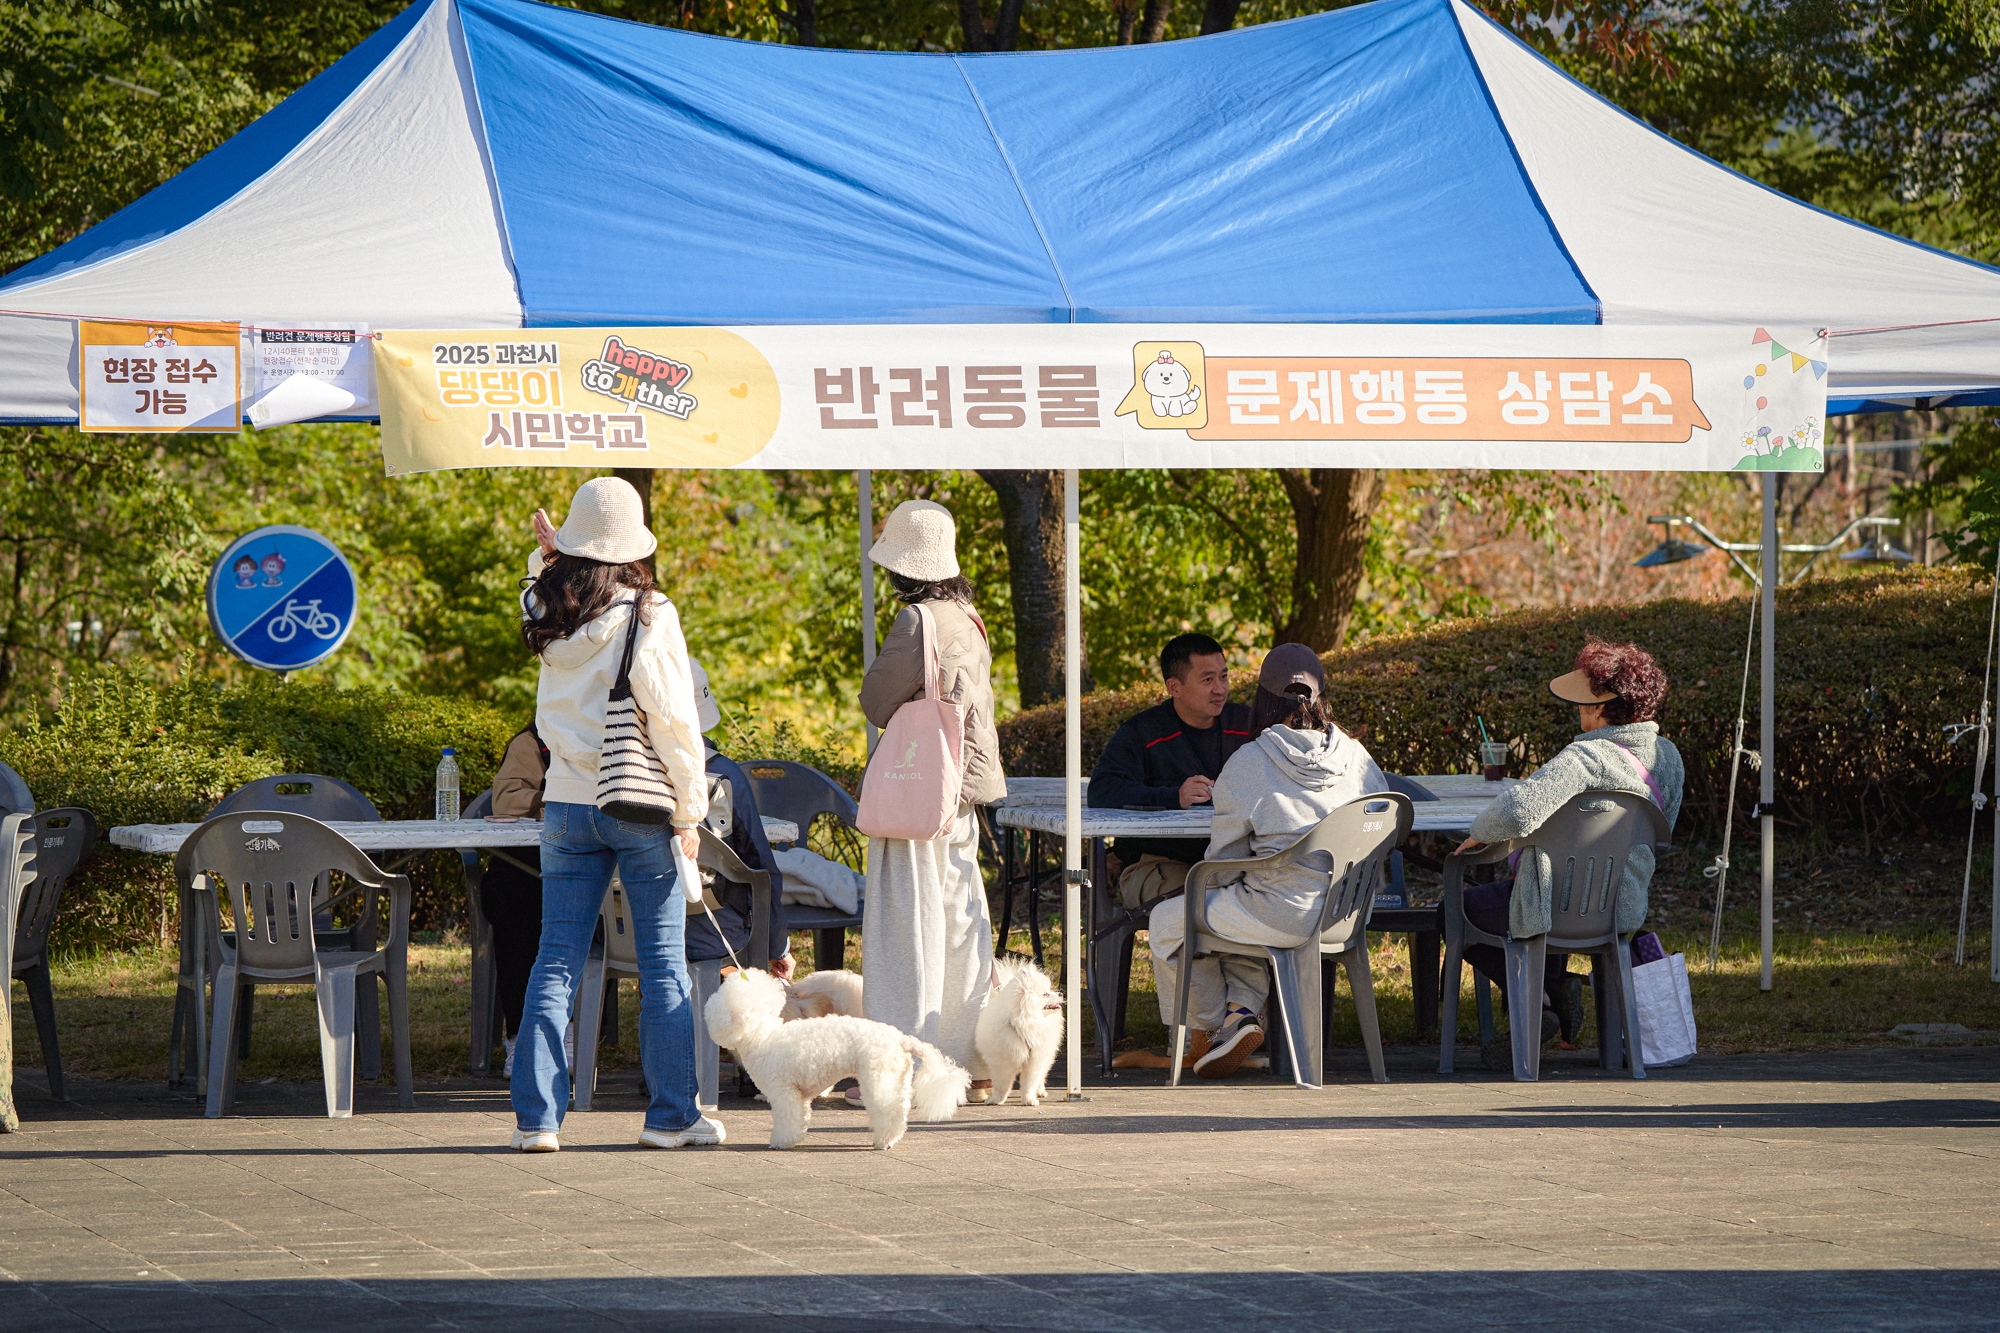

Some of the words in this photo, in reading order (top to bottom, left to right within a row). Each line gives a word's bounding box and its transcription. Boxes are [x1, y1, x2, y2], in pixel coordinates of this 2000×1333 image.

[265, 331, 294, 342] 반려견
[307, 347, 338, 356] 일부타임
[434, 345, 490, 365] 2025
[495, 344, 559, 365] 과천시
[103, 357, 158, 384] 현장
[164, 357, 218, 384] 접수
[606, 341, 687, 387] happy
[134, 389, 188, 415] 가능
[439, 371, 562, 407] 댕댕이
[587, 365, 692, 414] to개ther
[813, 365, 1101, 430] 반려동물
[1226, 368, 1468, 426] 문제행동
[1497, 370, 1675, 426] 상담소
[484, 412, 648, 449] 시민학교
